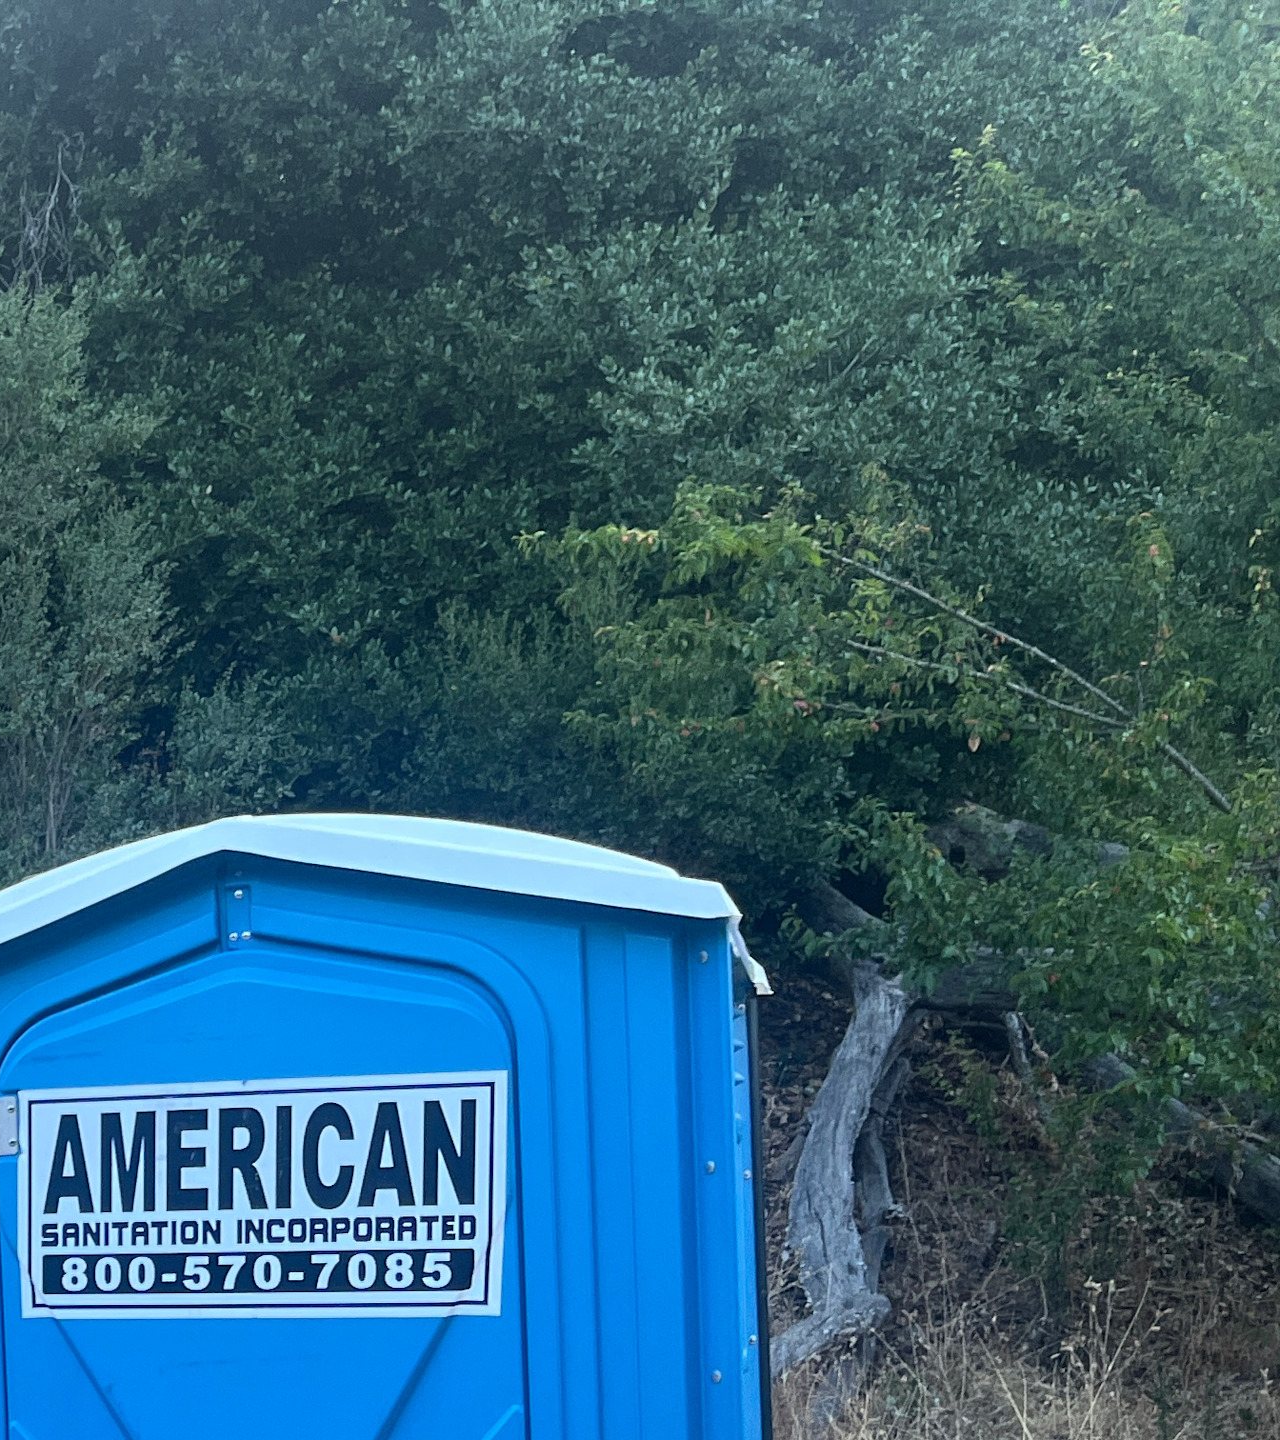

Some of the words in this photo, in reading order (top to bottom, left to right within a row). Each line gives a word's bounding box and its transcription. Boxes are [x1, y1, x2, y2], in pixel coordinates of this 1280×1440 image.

[43, 1098, 477, 1214] AMERICAN
[41, 1220, 221, 1247] SANITATION
[237, 1215, 477, 1244] INCORPORATED
[60, 1252, 453, 1291] 800-570-7085
